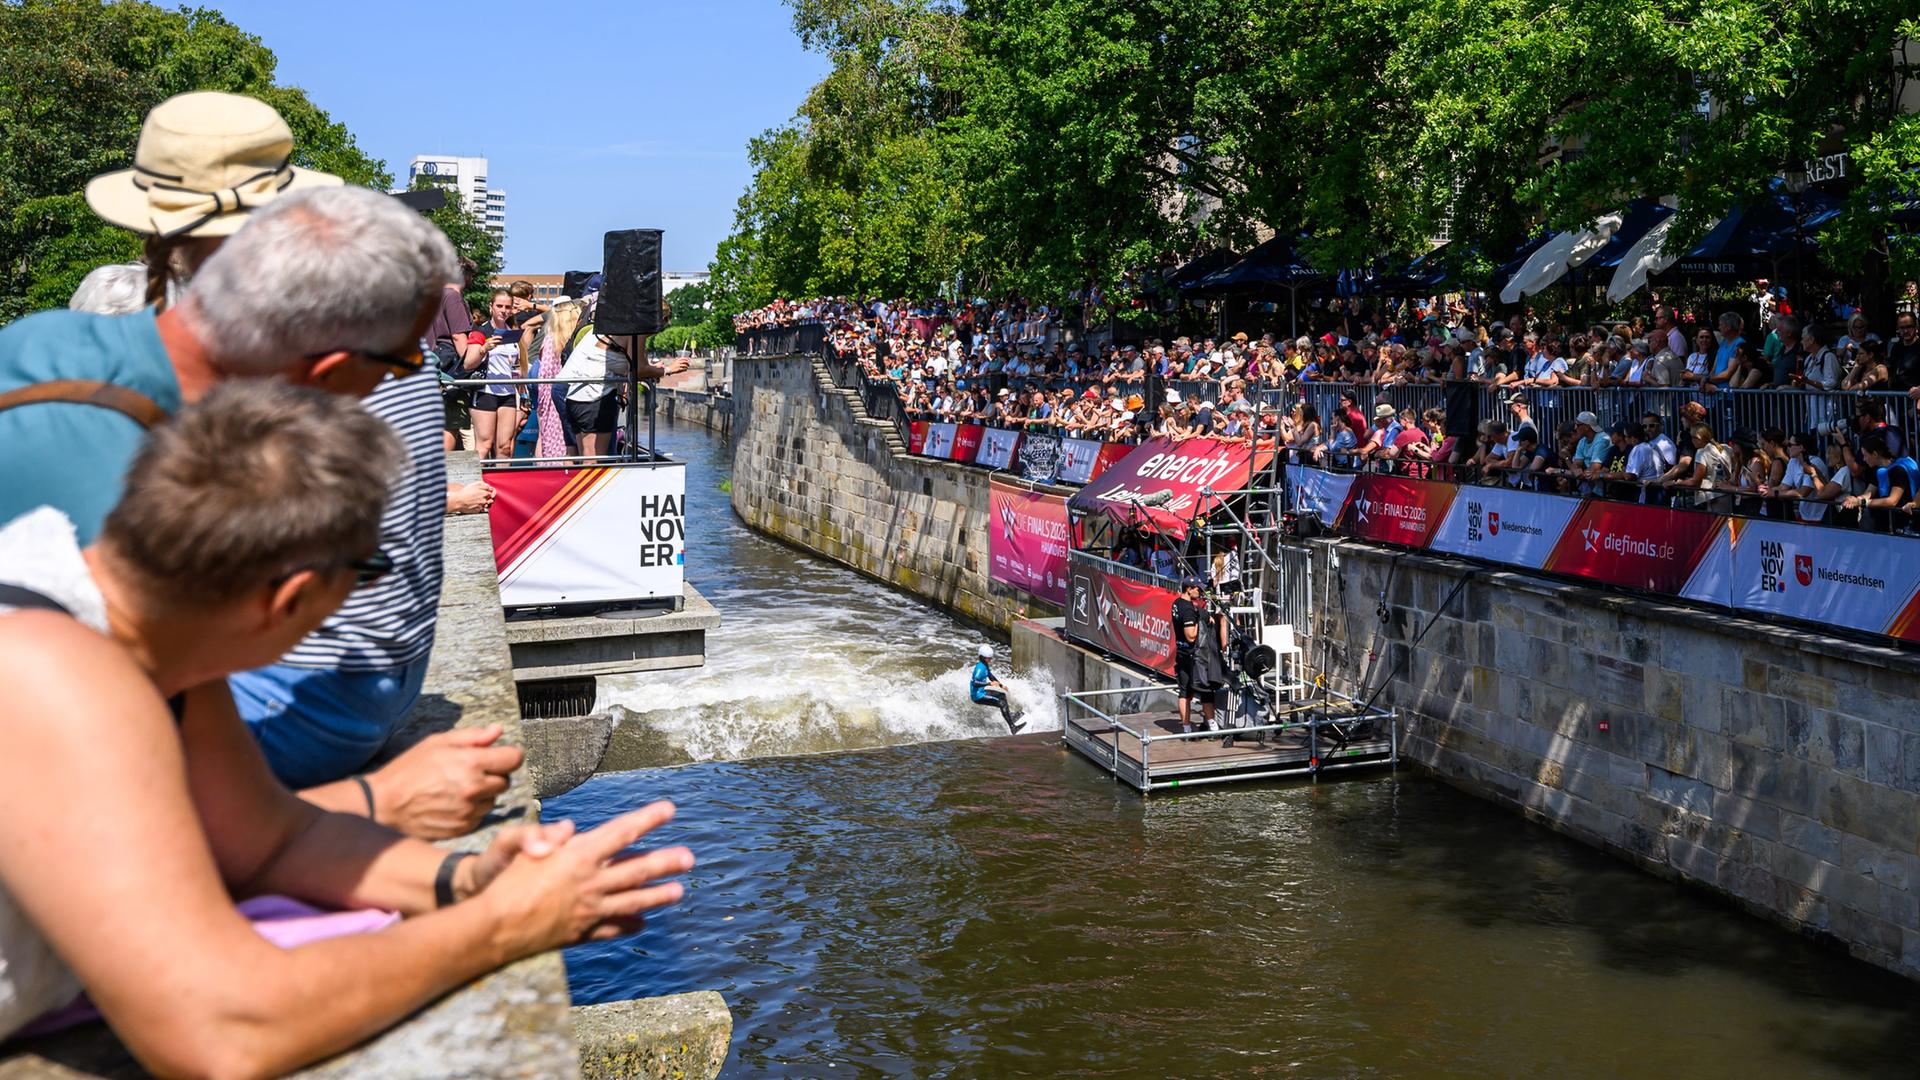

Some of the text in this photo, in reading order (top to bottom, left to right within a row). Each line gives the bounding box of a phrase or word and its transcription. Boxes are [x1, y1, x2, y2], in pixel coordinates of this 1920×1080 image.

[1136, 450, 1240, 492] enercity
[1384, 502, 1409, 519] FINALS
[1409, 506, 1426, 521] 2026
[1027, 515, 1050, 538] FINALS
[1050, 521, 1066, 541] 2026
[1468, 528, 1478, 541] ER
[1501, 520, 1543, 536] Niedersachsen
[640, 543, 674, 567] ER
[1604, 532, 1674, 560] diefinals.de
[1761, 540, 1784, 558] HAN
[1761, 558, 1784, 576] NOV
[1762, 575, 1777, 592] ER
[1818, 567, 1885, 589] Niedersachsen
[1123, 608, 1151, 634] FINALS
[1150, 616, 1171, 641] 2026
